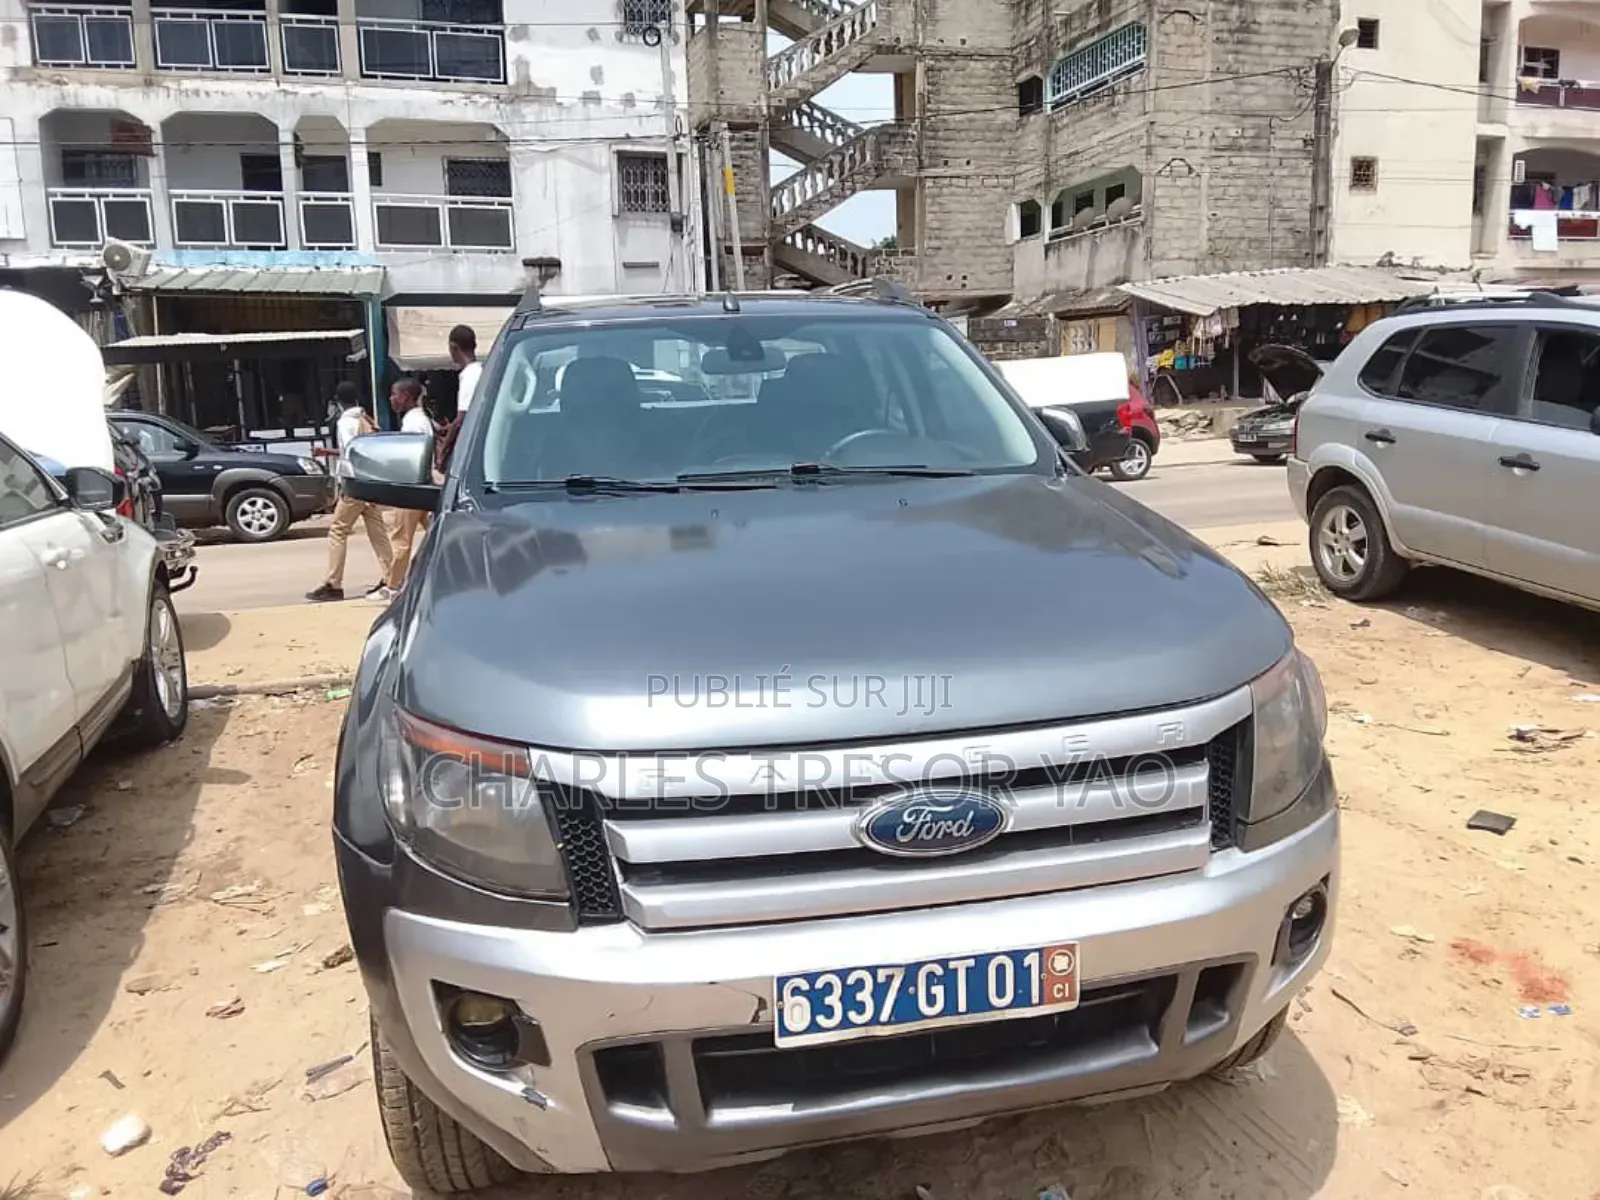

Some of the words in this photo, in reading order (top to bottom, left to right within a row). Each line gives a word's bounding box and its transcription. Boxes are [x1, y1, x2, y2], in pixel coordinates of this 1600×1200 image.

[896, 804, 974, 843] Ford
[782, 967, 906, 1034] 6337
[917, 959, 976, 1017] GT
[987, 951, 1041, 1008] 01
[1053, 982, 1070, 998] CI
